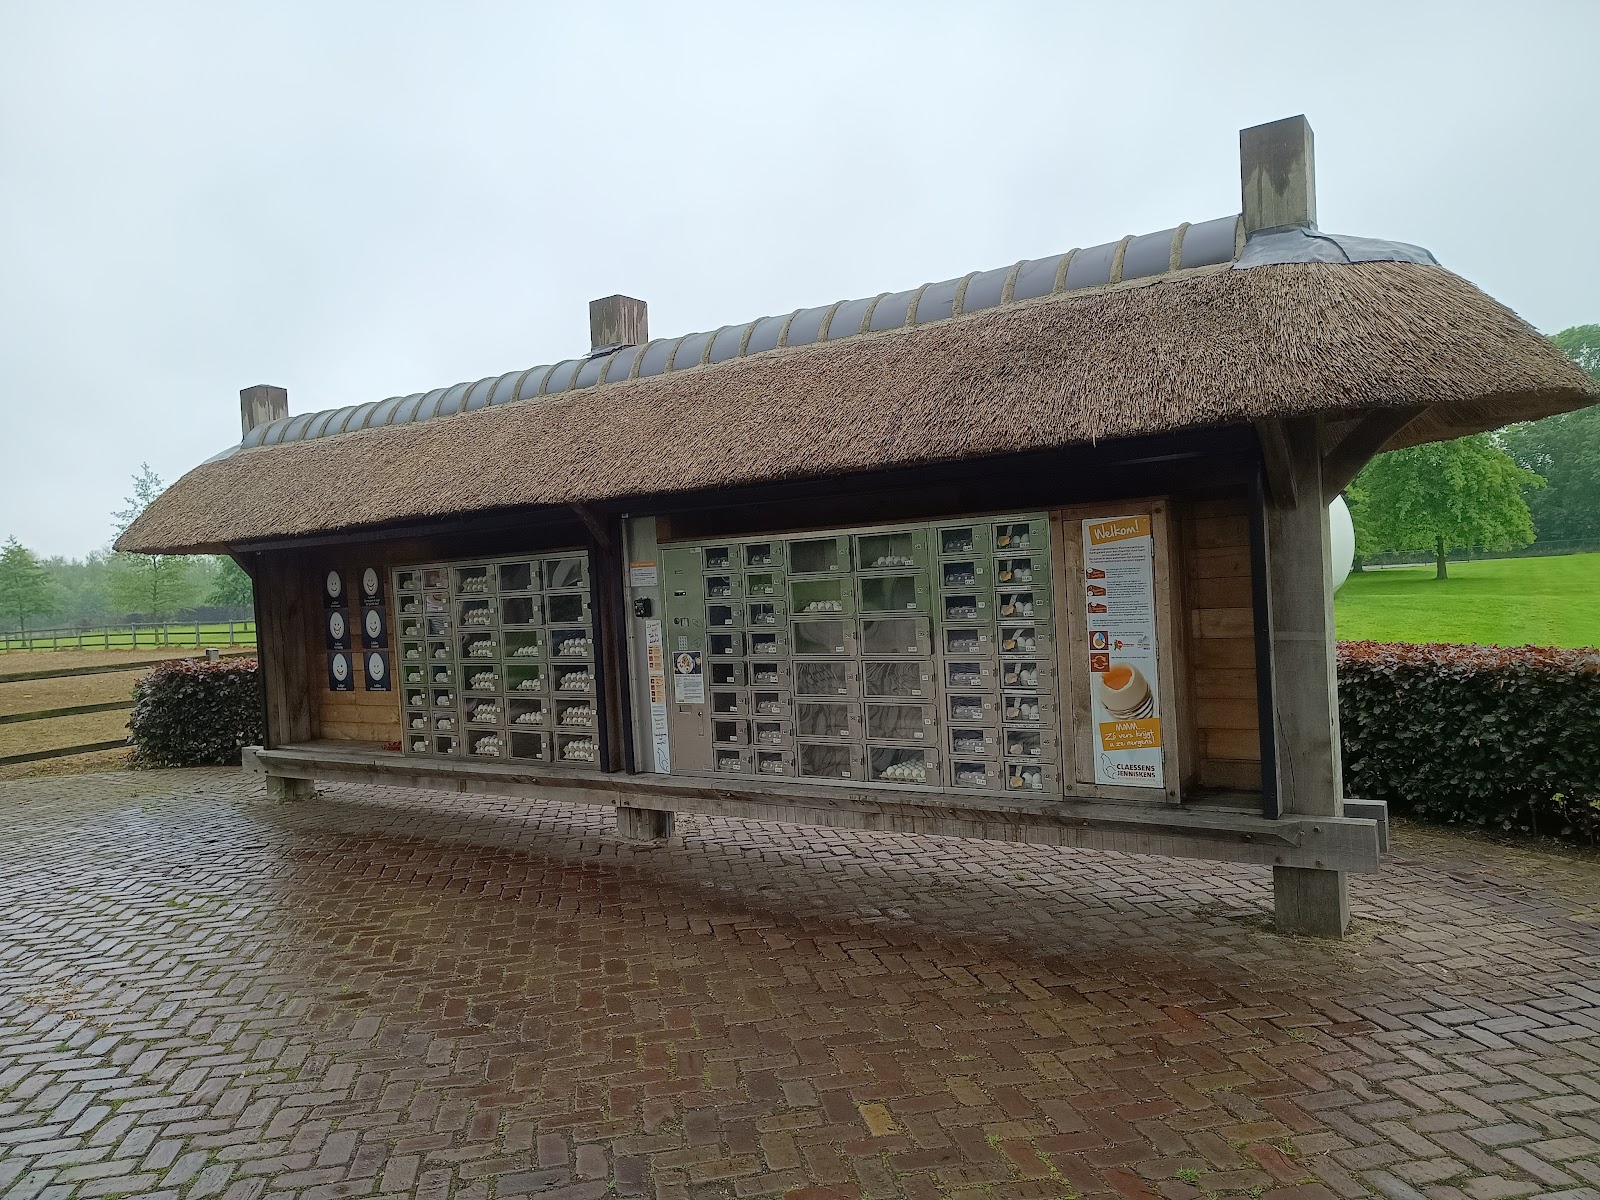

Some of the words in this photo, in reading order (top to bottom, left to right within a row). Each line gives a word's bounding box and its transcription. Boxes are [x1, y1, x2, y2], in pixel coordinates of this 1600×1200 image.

[1094, 518, 1139, 540] Welkom!
[1104, 731, 1117, 741] Zó
[1135, 729, 1154, 739] krijgt
[1126, 736, 1155, 748] nergens!
[1116, 763, 1155, 772] CLAESSENS
[1117, 770, 1156, 778] JENNISKENS
